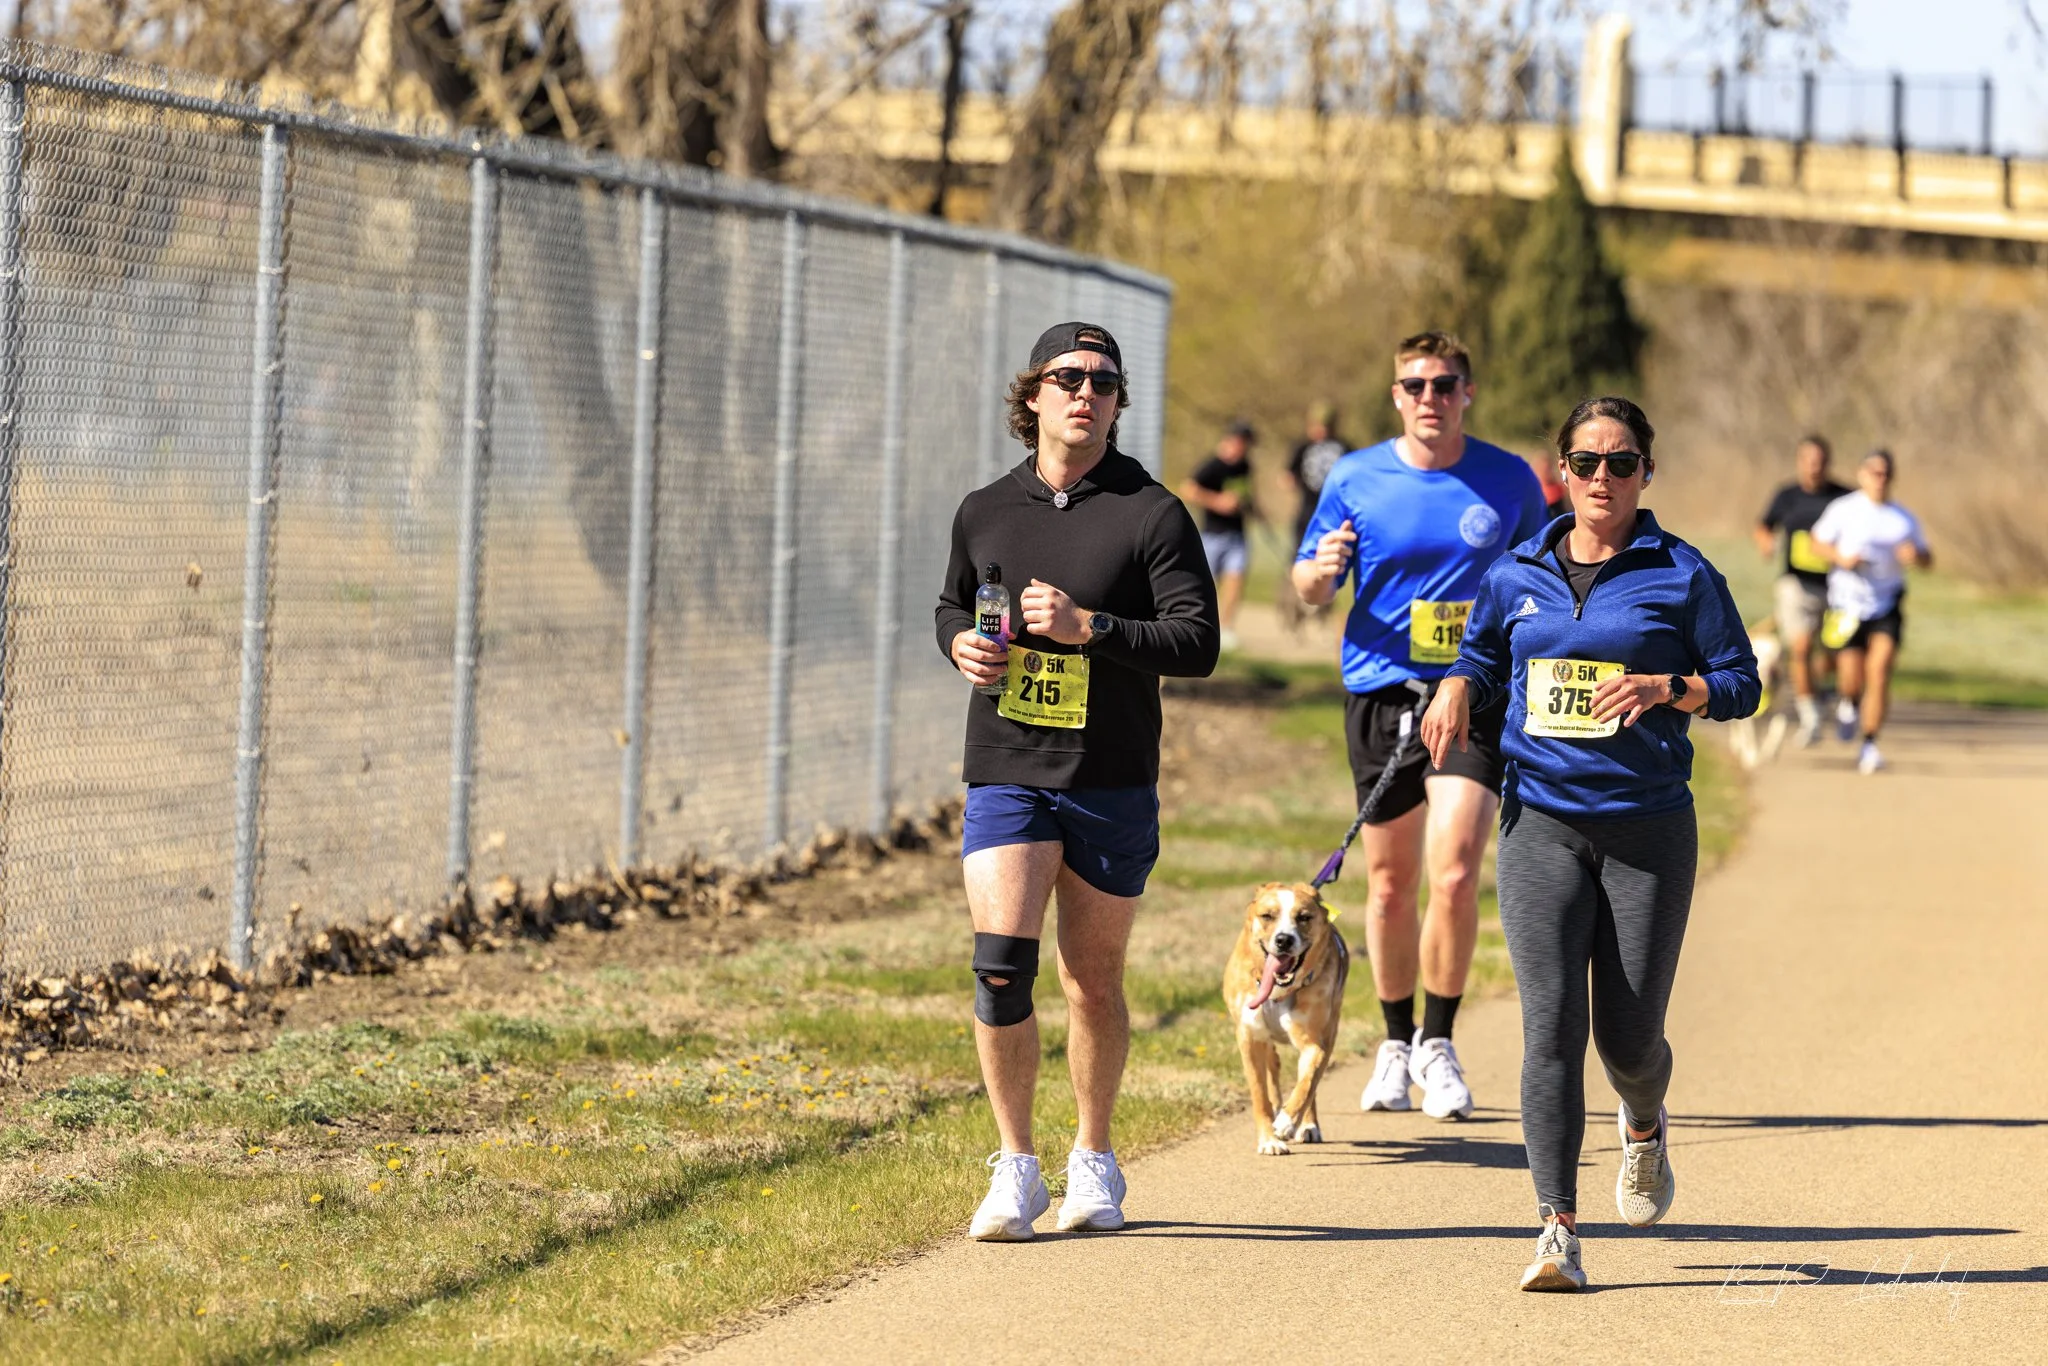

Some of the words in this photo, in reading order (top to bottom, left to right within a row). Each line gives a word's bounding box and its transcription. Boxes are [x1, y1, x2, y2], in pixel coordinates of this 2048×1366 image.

[981, 616, 999, 624] LIFE
[981, 623, 999, 632] WTR
[1433, 624, 1464, 645] 419
[1046, 658, 1065, 674] 5K
[1577, 665, 1598, 682] 5K
[1019, 675, 1061, 706] 215
[1548, 686, 1593, 717] 375
